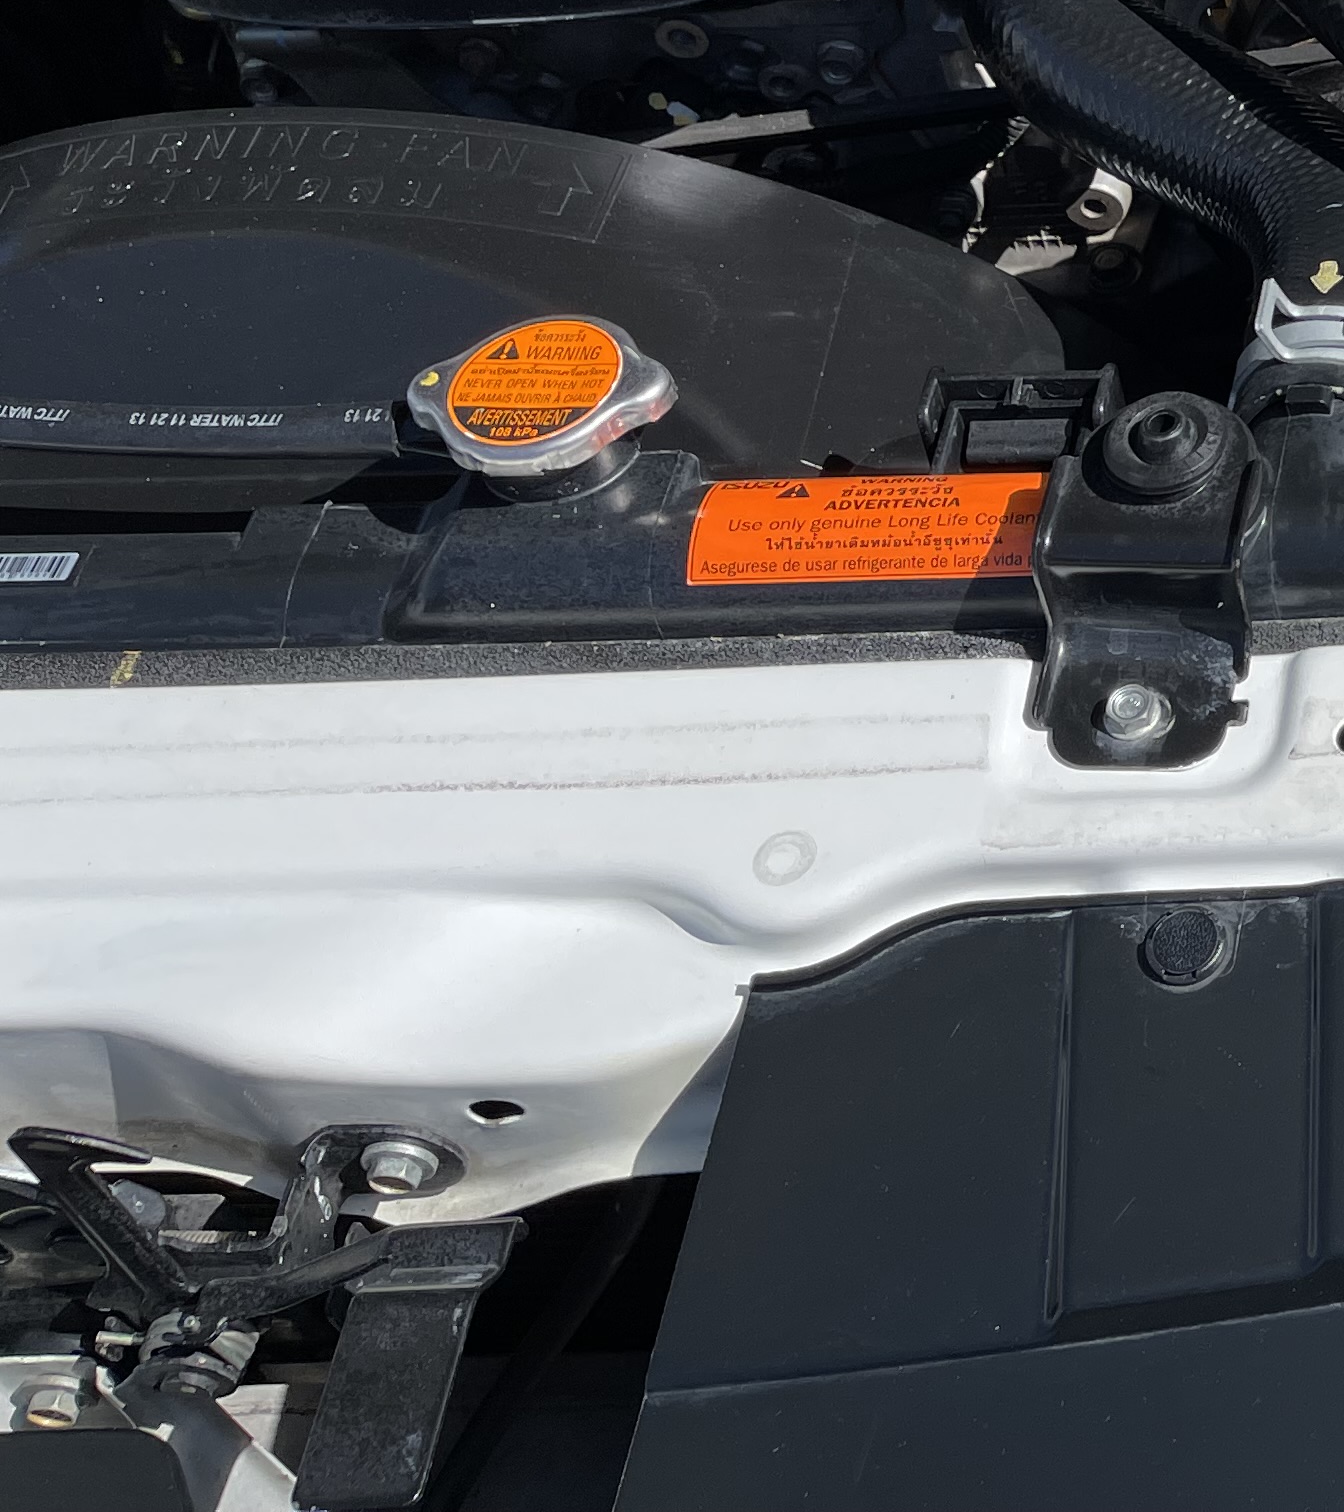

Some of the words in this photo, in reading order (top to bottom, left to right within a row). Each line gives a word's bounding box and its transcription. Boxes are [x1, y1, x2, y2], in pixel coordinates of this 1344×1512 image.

[59, 125, 360, 177] WARNING
[396, 133, 528, 175] FAN
[526, 345, 602, 361] WARNING
[464, 378, 501, 388] NEVER
[506, 378, 536, 388] OPEN
[542, 378, 577, 390] WHEN
[580, 378, 605, 389] HOT
[456, 392, 470, 402] NE
[471, 392, 512, 403] JAMAIS
[514, 392, 551, 403] OUVRIR
[190, 413, 246, 427] WATER
[466, 407, 572, 427] AVERTISSEMENT
[489, 426, 511, 437] 108
[513, 426, 539, 437] kPa
[721, 480, 790, 490] ISUZU
[861, 476, 948, 485] WARNING
[823, 497, 960, 512] ADVERTENCIA
[728, 519, 763, 532] Use
[769, 517, 806, 533] only
[809, 517, 882, 533] genuine
[888, 515, 931, 530] Long
[936, 513, 968, 526] Life
[975, 512, 1041, 526] Coolan
[700, 560, 778, 577] Asegurese
[782, 558, 801, 572] de
[805, 559, 838, 572] usar
[842, 554, 926, 574] refrigerante
[930, 554, 948, 569] de
[953, 553, 989, 570] larga
[993, 552, 1023, 566] vida
